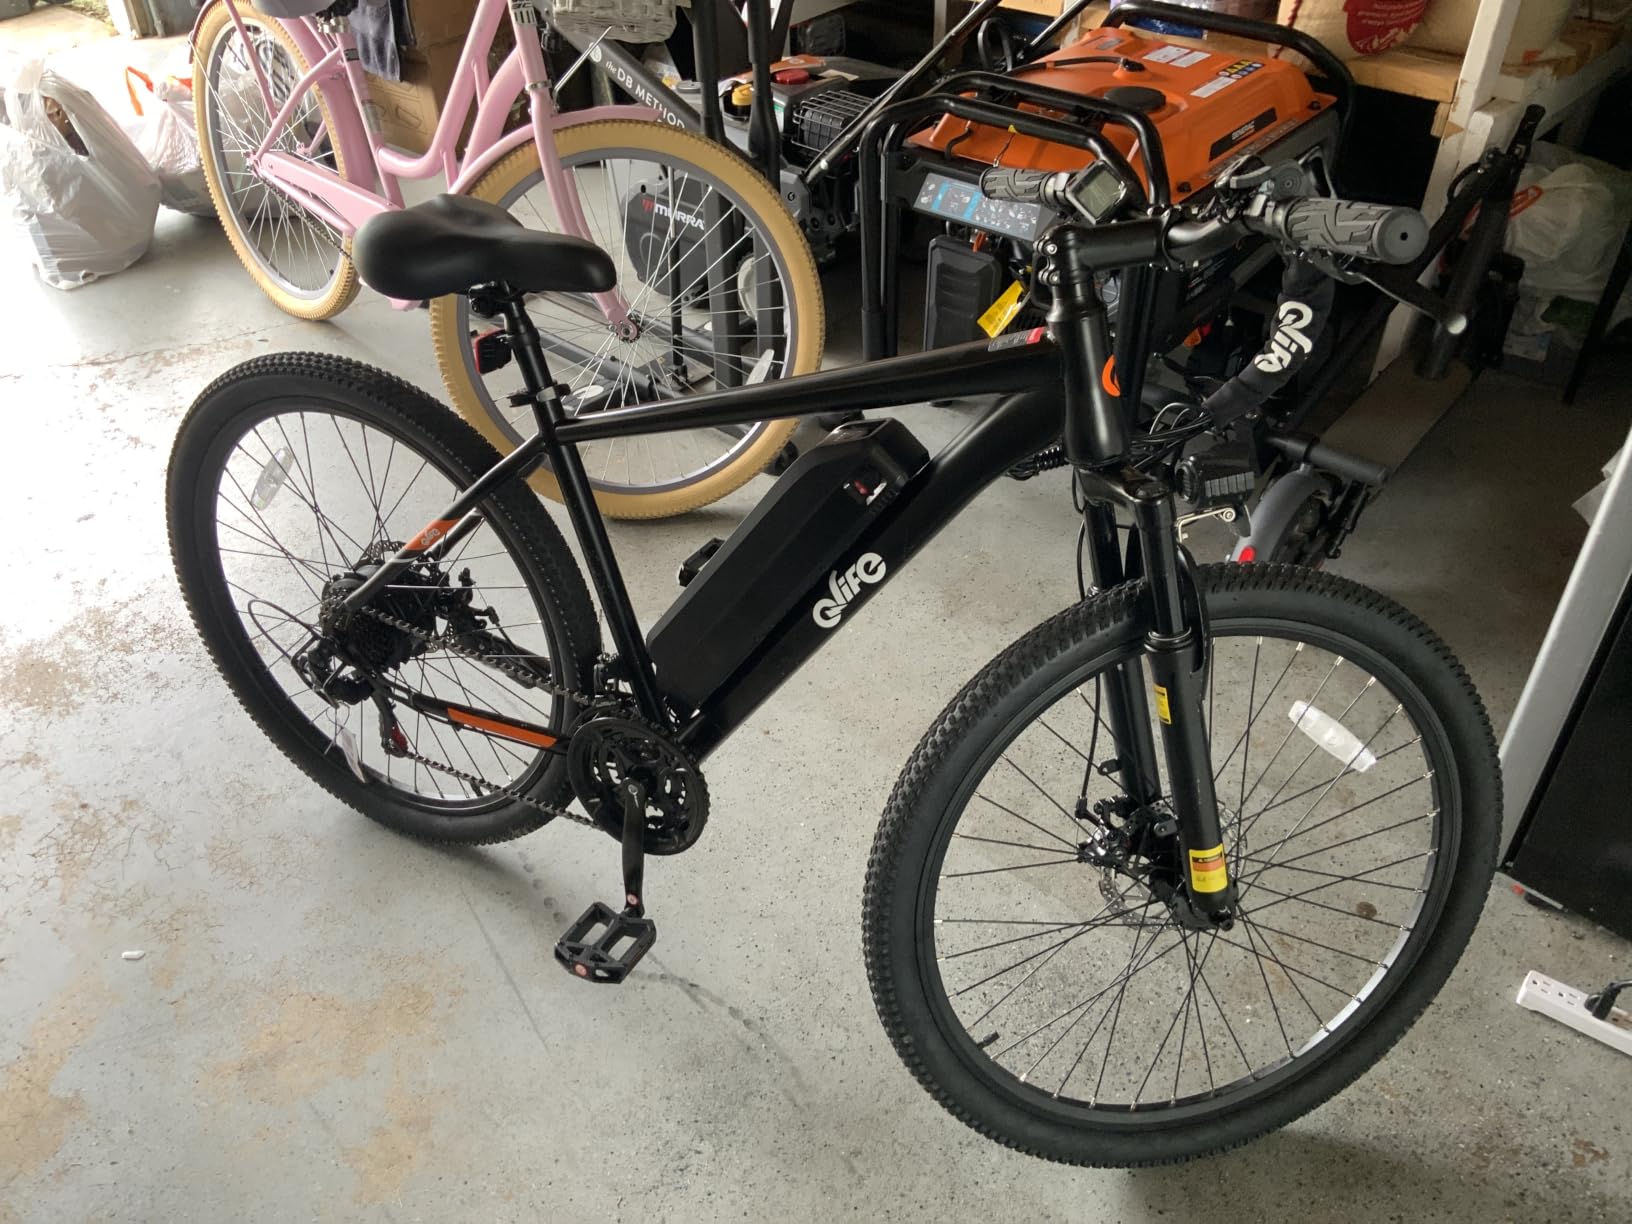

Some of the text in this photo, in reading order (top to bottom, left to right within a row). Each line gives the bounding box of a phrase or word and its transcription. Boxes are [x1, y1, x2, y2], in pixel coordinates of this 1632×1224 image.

[605, 60, 617, 74] the
[617, 68, 633, 89] DB
[655, 203, 705, 231] MURRA
